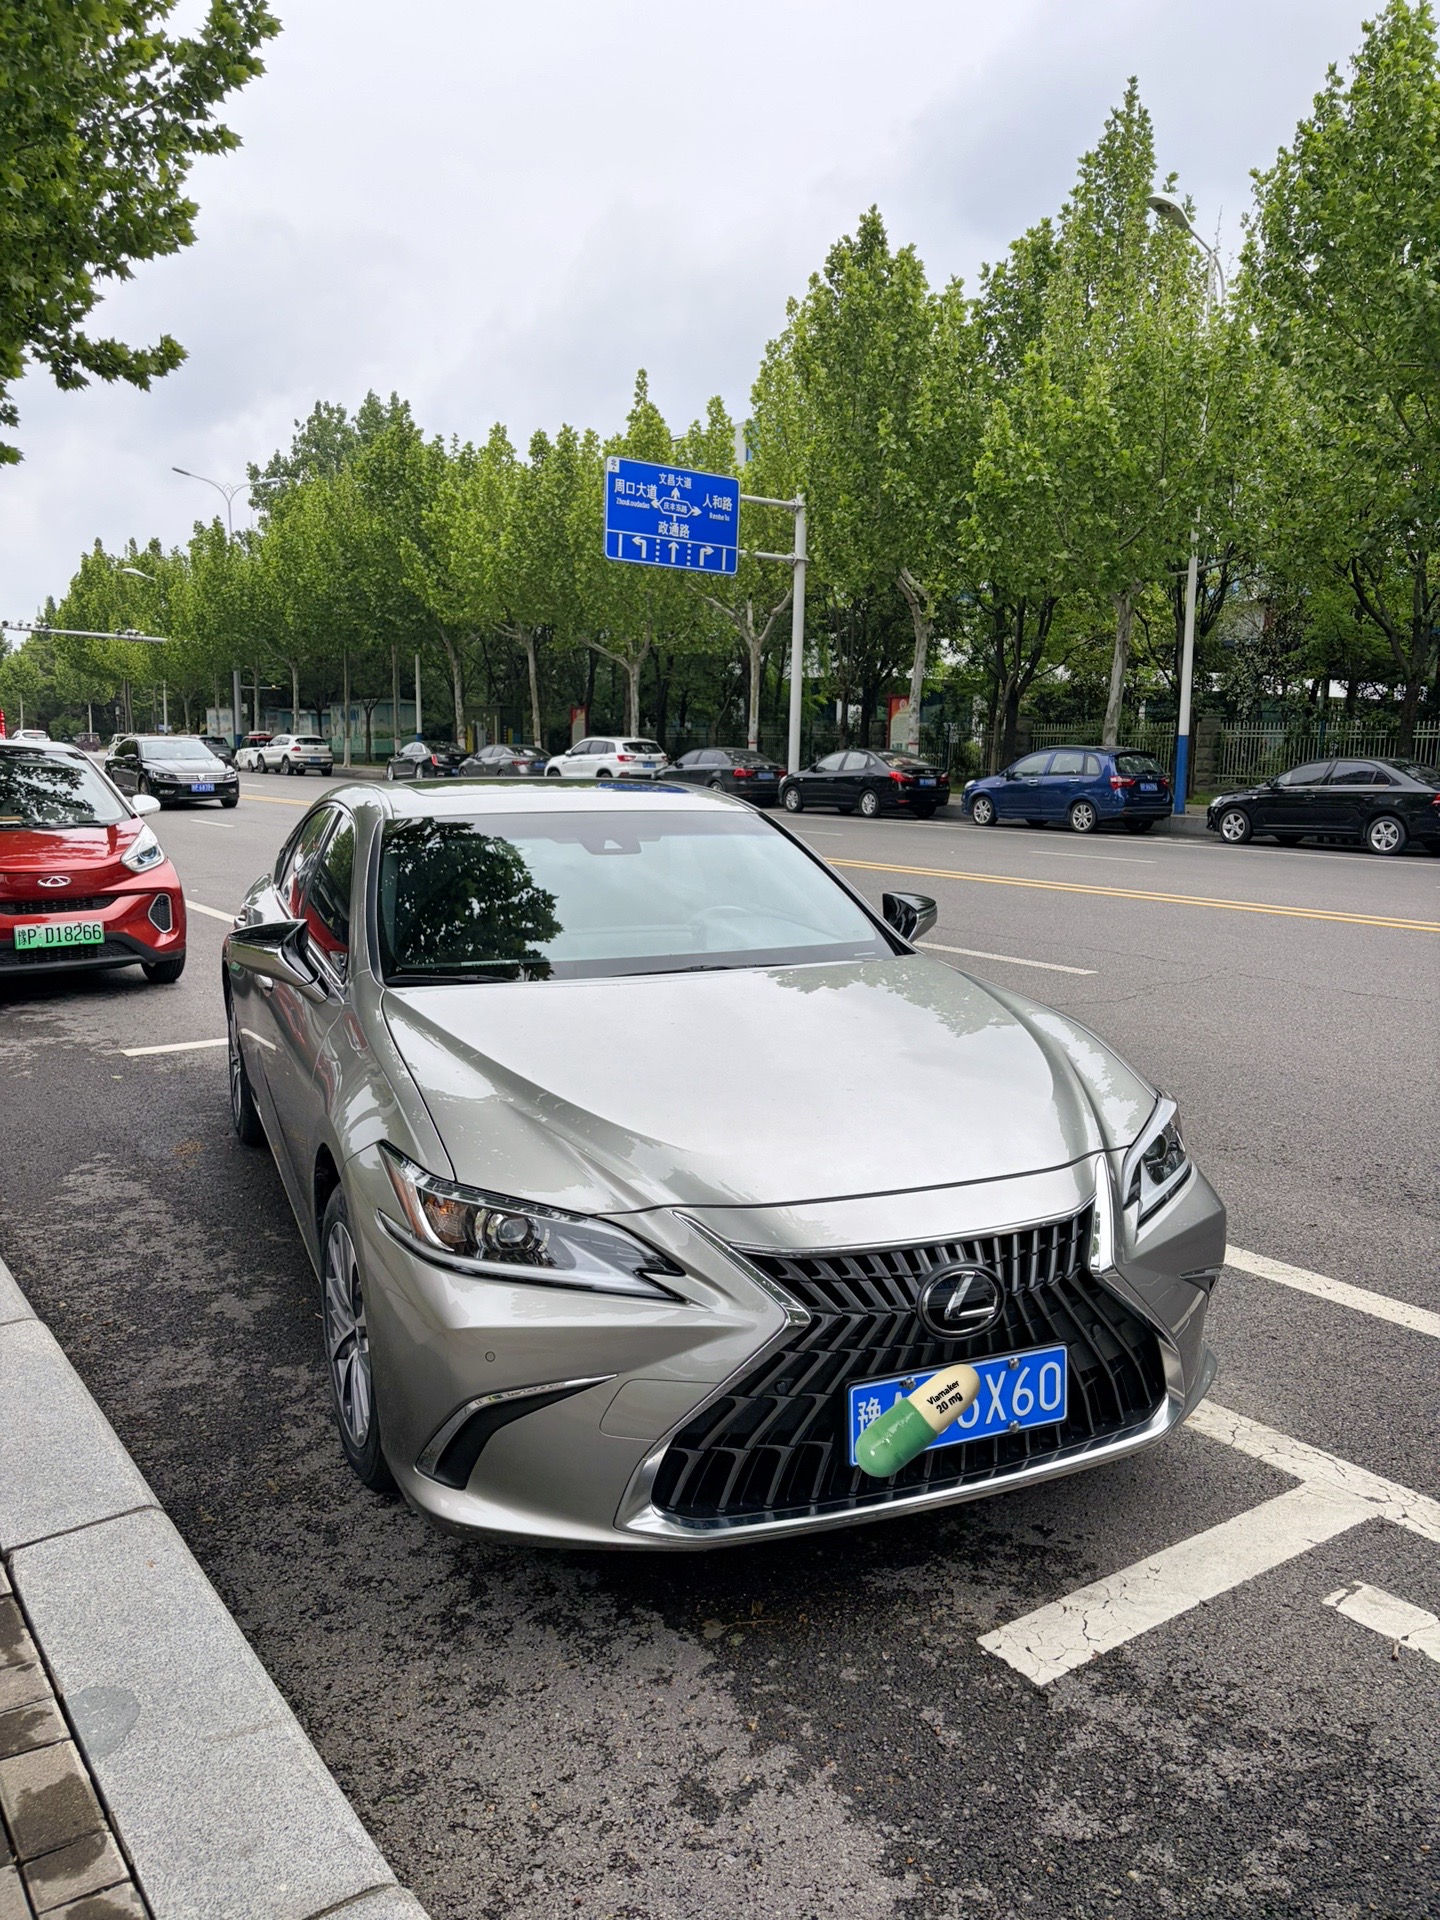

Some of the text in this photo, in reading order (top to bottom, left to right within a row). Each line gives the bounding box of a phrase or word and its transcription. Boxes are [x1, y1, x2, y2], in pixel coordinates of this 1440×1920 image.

[614, 478, 658, 500] 周口大道
[658, 472, 692, 490] 文昌大道
[702, 493, 733, 512] 人和路
[658, 520, 690, 539] 政通路
